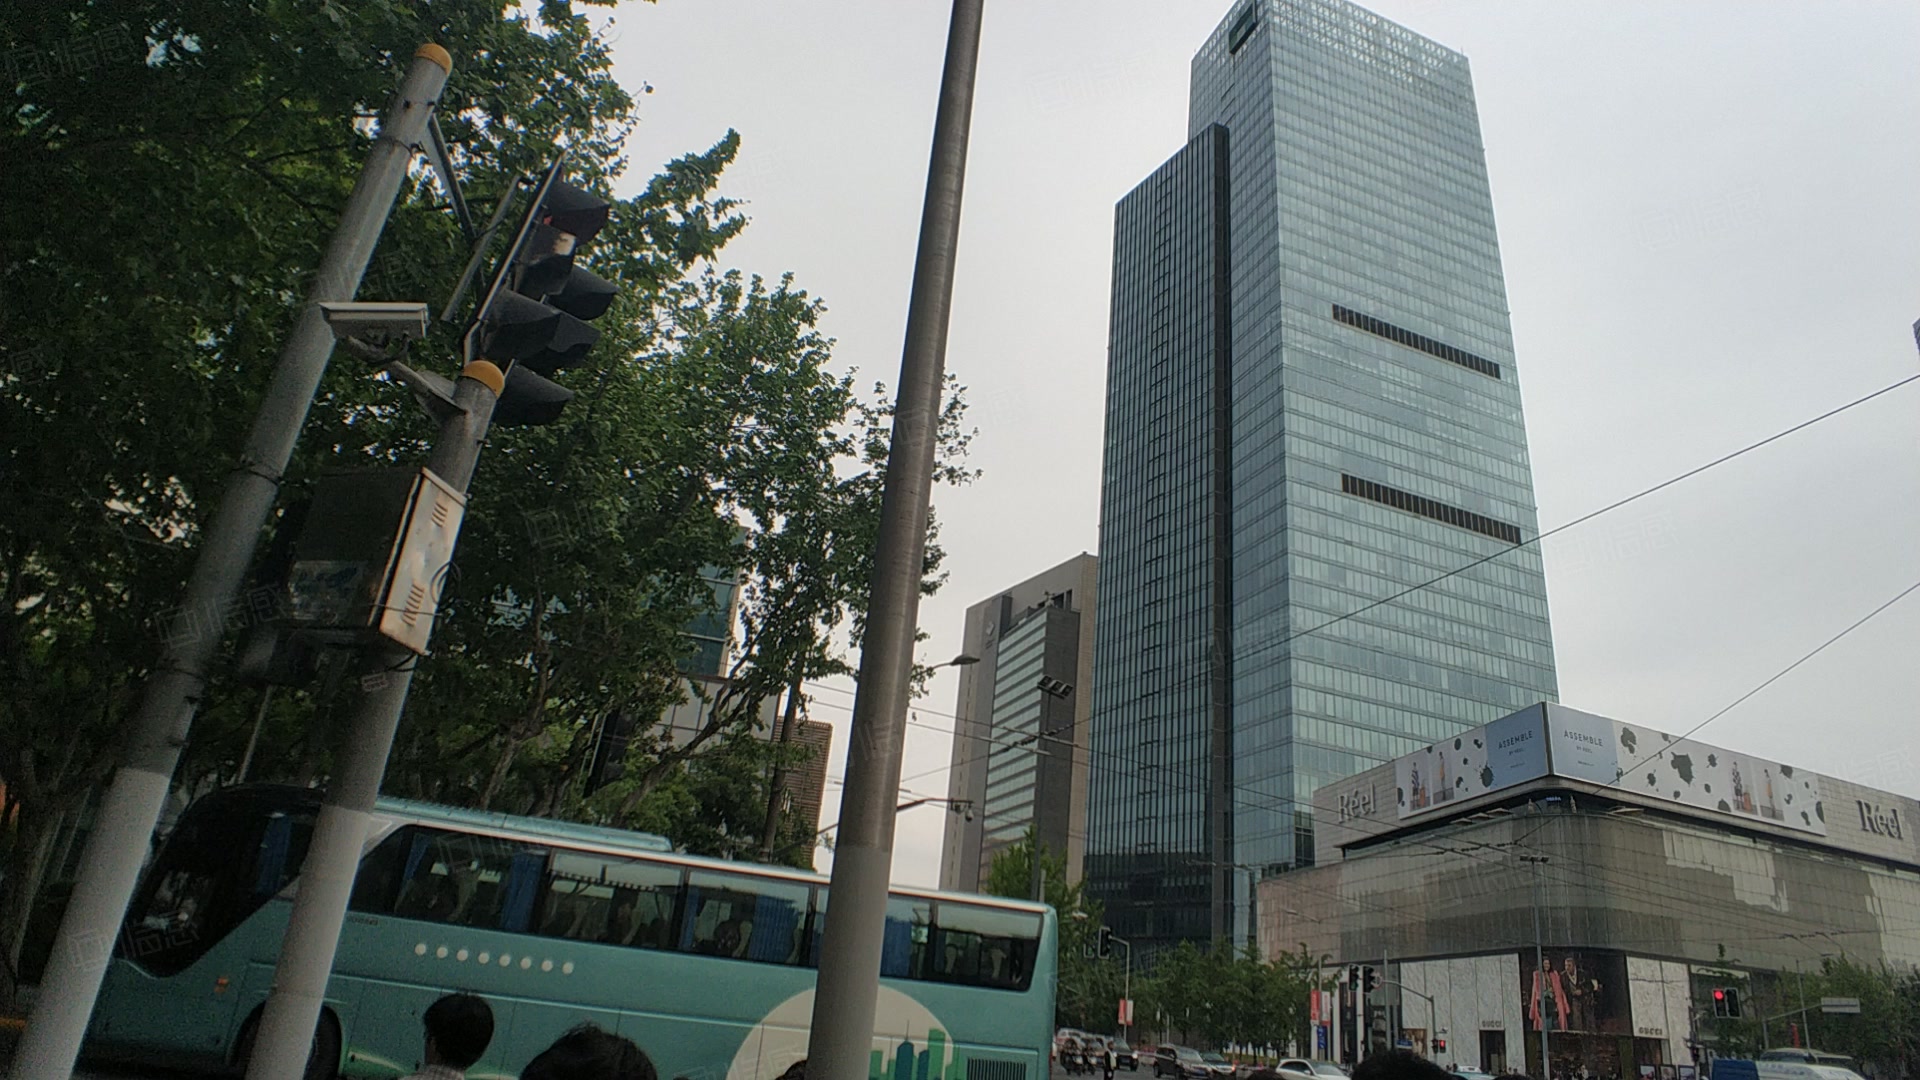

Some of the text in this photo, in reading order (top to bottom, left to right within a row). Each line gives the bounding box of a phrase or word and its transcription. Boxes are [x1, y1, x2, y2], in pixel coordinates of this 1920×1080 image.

[1499, 731, 1532, 748] ASSEMBLE
[1564, 730, 1603, 746] ASSEMBLE
[1336, 783, 1377, 825] Réel
[1855, 799, 1904, 840] Réel
[1481, 1020, 1503, 1028] GUCCI
[1638, 1027, 1663, 1036] GUCCI
